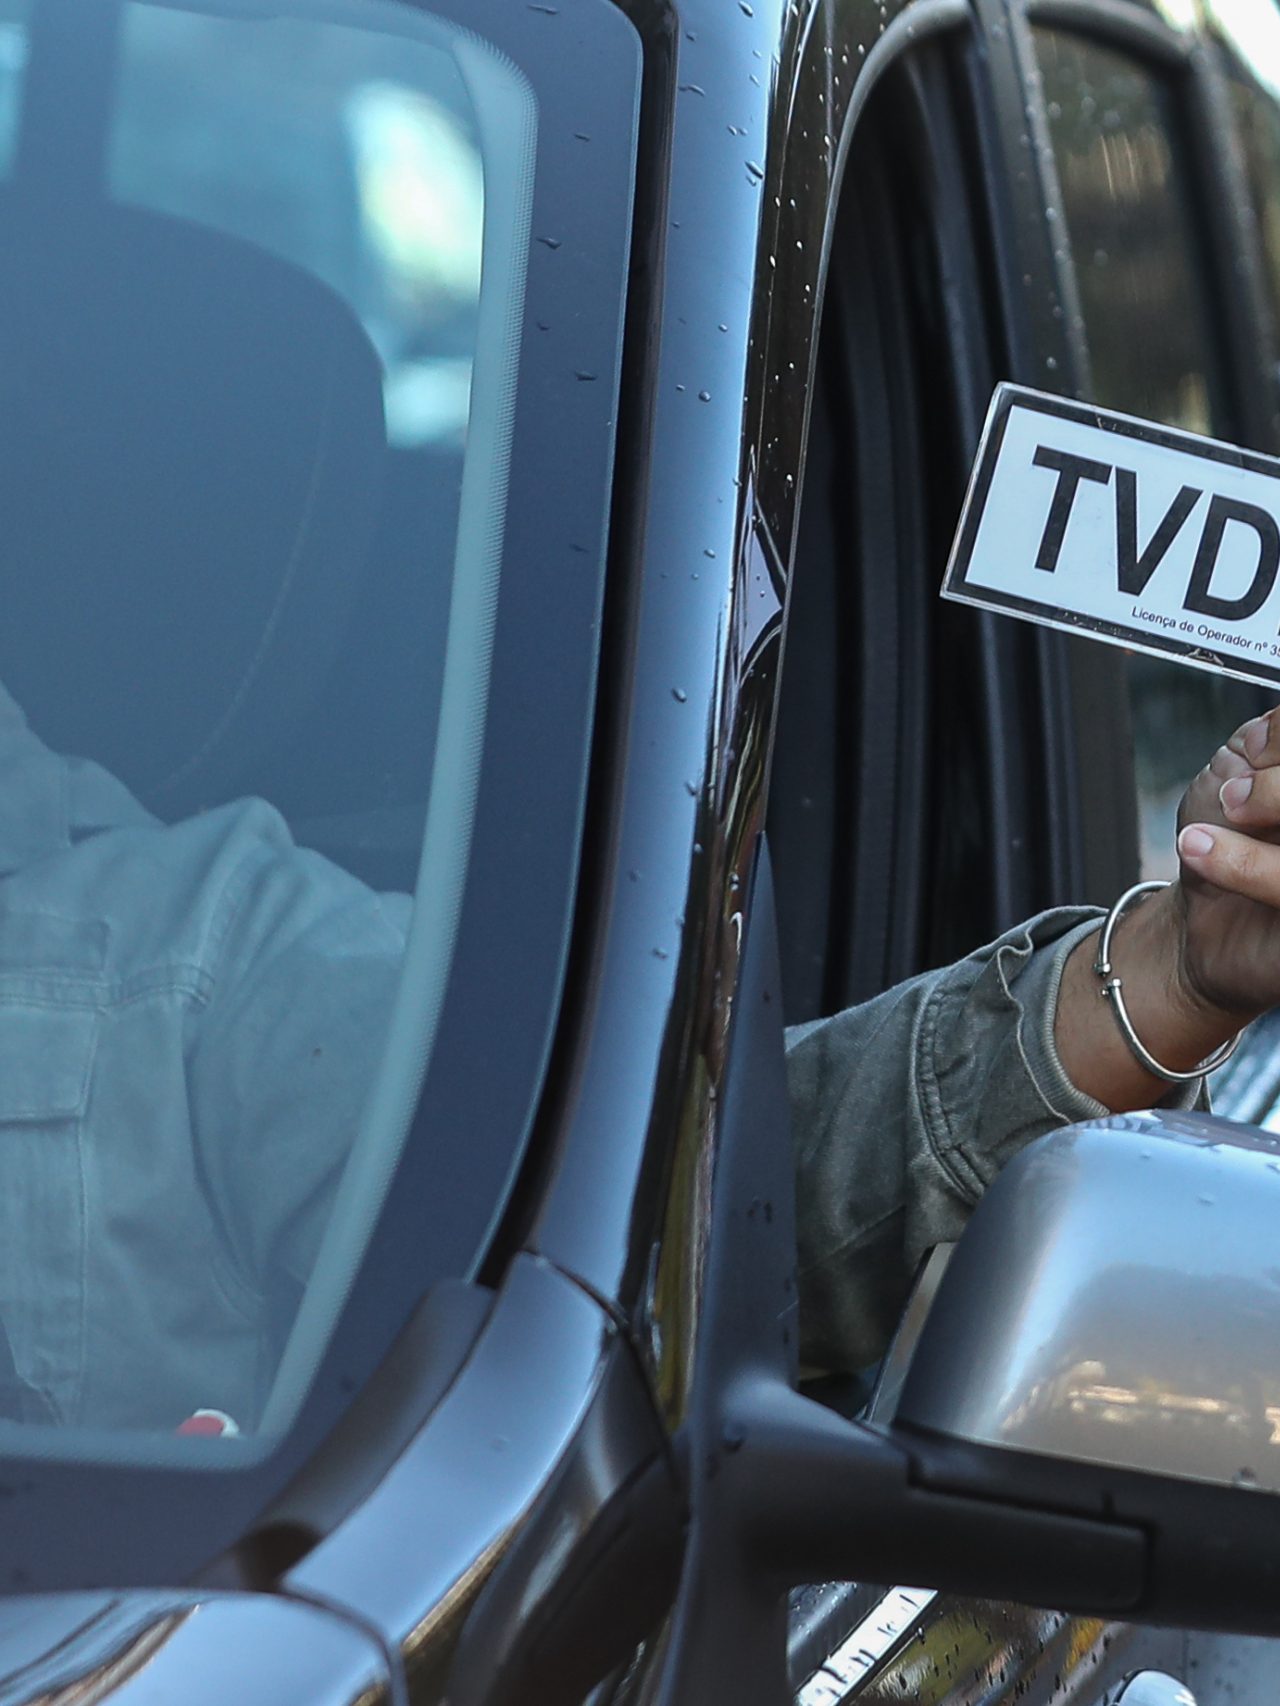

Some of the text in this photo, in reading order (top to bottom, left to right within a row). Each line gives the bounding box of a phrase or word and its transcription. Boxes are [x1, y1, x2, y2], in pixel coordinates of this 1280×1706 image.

[1131, 606, 1176, 628] Licença
[1179, 619, 1195, 633] de
[1197, 624, 1252, 649] Operador
